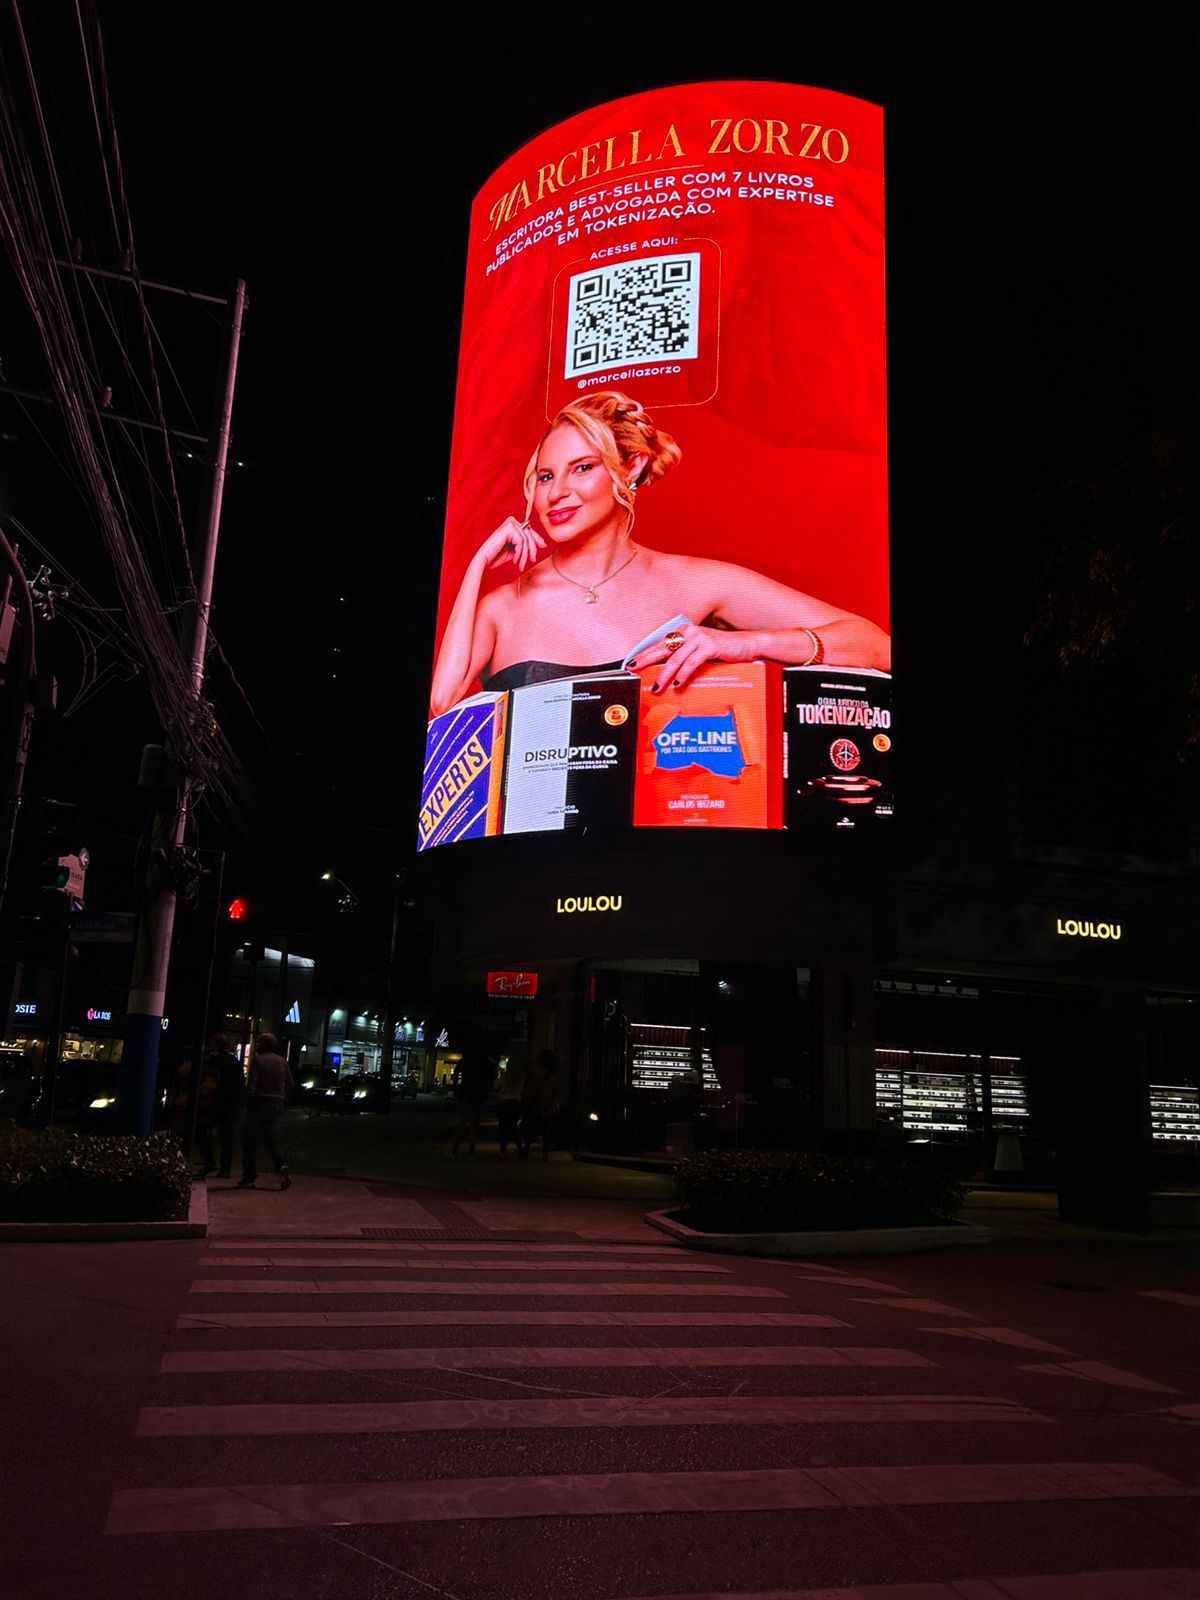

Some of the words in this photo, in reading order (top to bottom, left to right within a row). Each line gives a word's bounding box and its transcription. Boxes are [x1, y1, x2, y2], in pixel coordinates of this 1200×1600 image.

[483, 123, 686, 241] MARCELLA
[708, 117, 850, 165] ZORZO
[495, 207, 565, 255] ESCRITORA
[568, 176, 676, 211] BEST-SELLER
[682, 171, 726, 186] COM
[733, 172, 742, 182] 7
[748, 172, 815, 189] LIVROS
[556, 231, 580, 246] EM
[586, 202, 716, 235] TOKENIZAÇÃO.
[486, 222, 564, 277] PUBLICADOS
[567, 216, 577, 228] E
[580, 192, 681, 223] ADVOGADA
[687, 188, 732, 201] COM
[738, 188, 835, 208] EXPERTISE
[589, 242, 637, 261] ACESSE
[641, 237, 679, 249] AQUI:
[577, 366, 681, 389] @marcellazorzo
[796, 703, 891, 729] TOKENIZAÇÃO
[657, 731, 737, 747] OFF-LINE
[524, 744, 618, 762] DISRUPTIVO
[418, 741, 484, 838] EXPERTS
[557, 895, 622, 912] LOULOU
[1057, 919, 1121, 940] LOULOU
